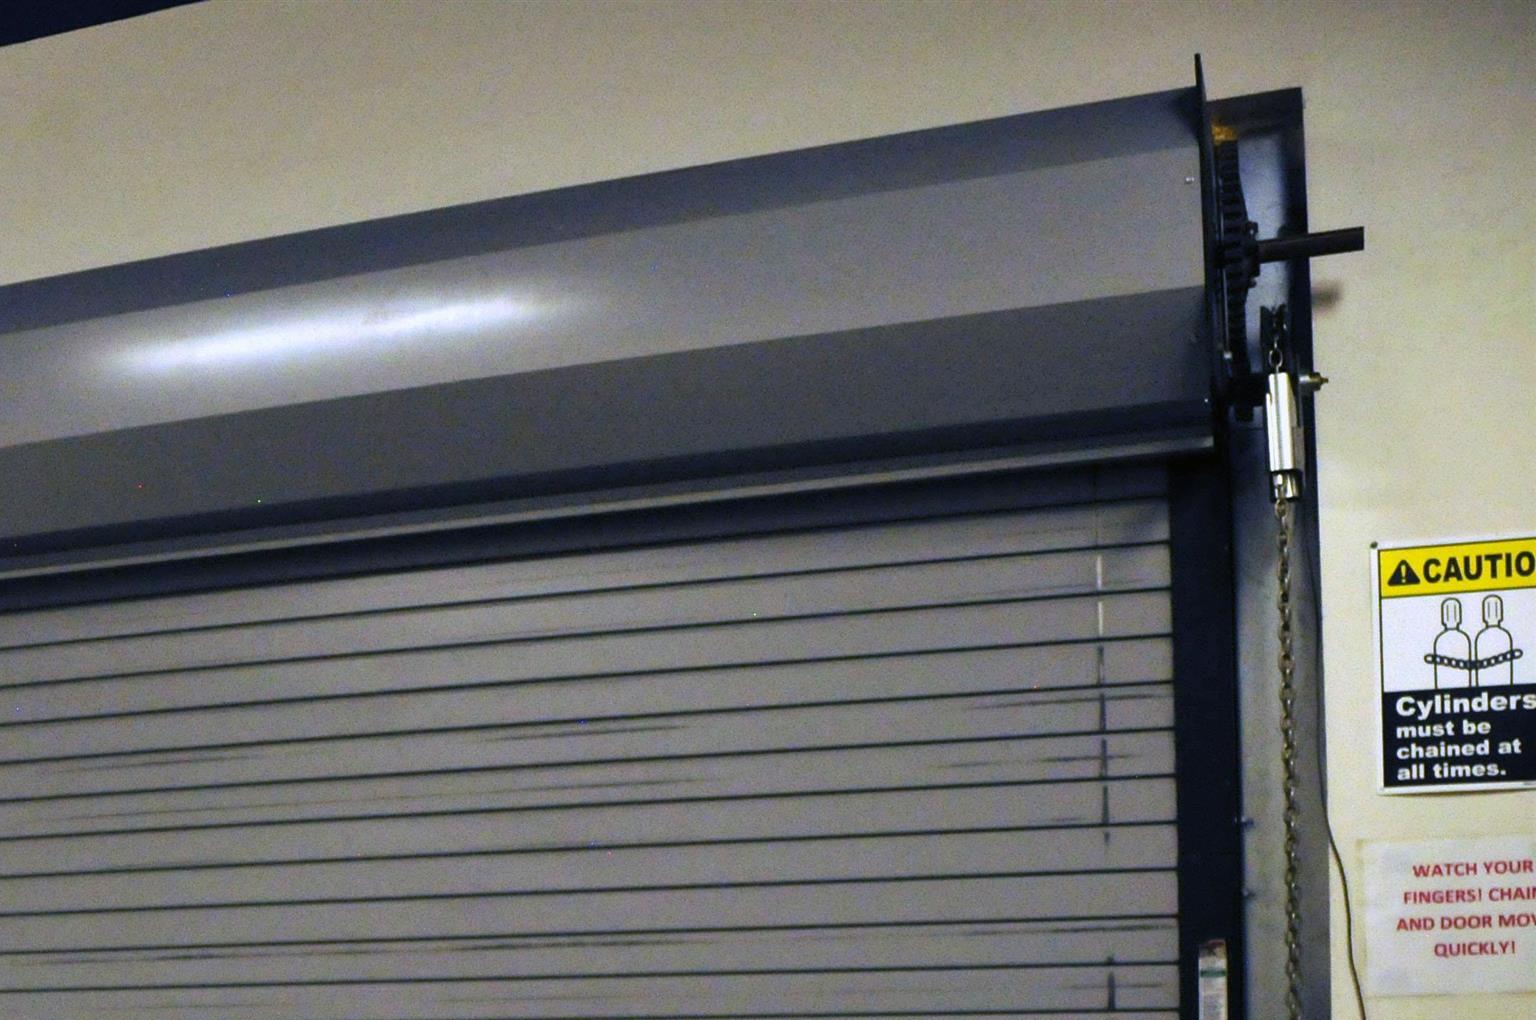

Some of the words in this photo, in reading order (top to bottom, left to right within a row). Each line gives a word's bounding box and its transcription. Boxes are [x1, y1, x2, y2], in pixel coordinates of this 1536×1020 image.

[1423, 551, 1536, 583] CAUTIO
[1396, 692, 1536, 720] Cylinders
[1396, 721, 1455, 738] must
[1462, 719, 1491, 735] be
[1396, 739, 1490, 760] chained
[1498, 738, 1522, 754] at
[1397, 763, 1425, 781] all
[1433, 762, 1507, 779] times.
[1412, 862, 1478, 878] WATCH
[1483, 859, 1534, 875] YOUR
[1403, 887, 1482, 905] FINGERS!
[1396, 917, 1435, 932] AND
[1440, 914, 1492, 930] DOOR
[1434, 940, 1516, 959] QUICKLY!
